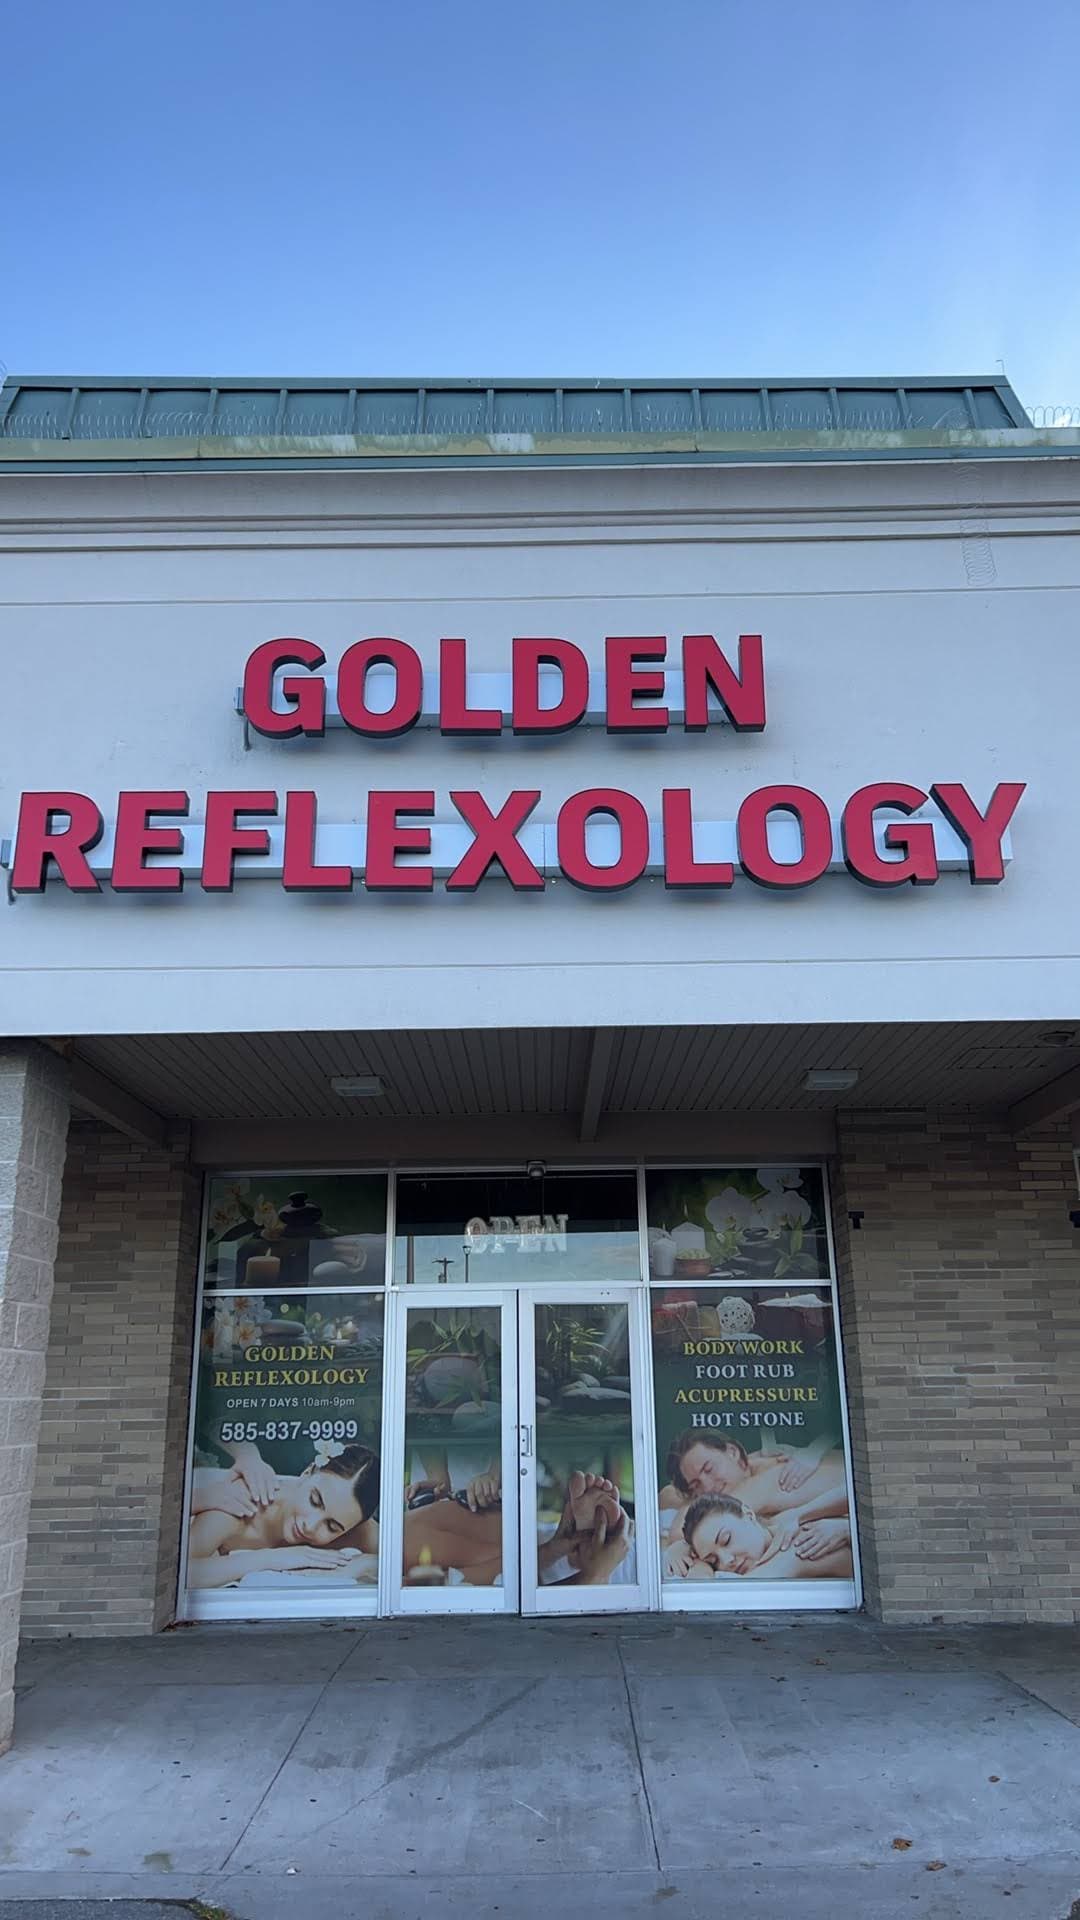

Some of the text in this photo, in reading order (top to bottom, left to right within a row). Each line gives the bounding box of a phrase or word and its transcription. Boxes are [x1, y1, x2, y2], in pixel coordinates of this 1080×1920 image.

[244, 635, 766, 739] GOLDEN
[10, 782, 1027, 893] REFLEXOLOGY
[464, 1214, 569, 1254] OPEN
[244, 1345, 336, 1362] GOLDEN
[683, 1340, 805, 1356] BODY WORK
[214, 1368, 369, 1387] REFLEXOLOGY
[695, 1363, 795, 1379] FOOT RUB
[226, 1396, 355, 1409] OPEN 7 DAYS 10am-9pm
[674, 1387, 818, 1403] ACUPRESSURE
[691, 1411, 805, 1427] HOT STONE
[220, 1419, 358, 1442] 585-837-9999
